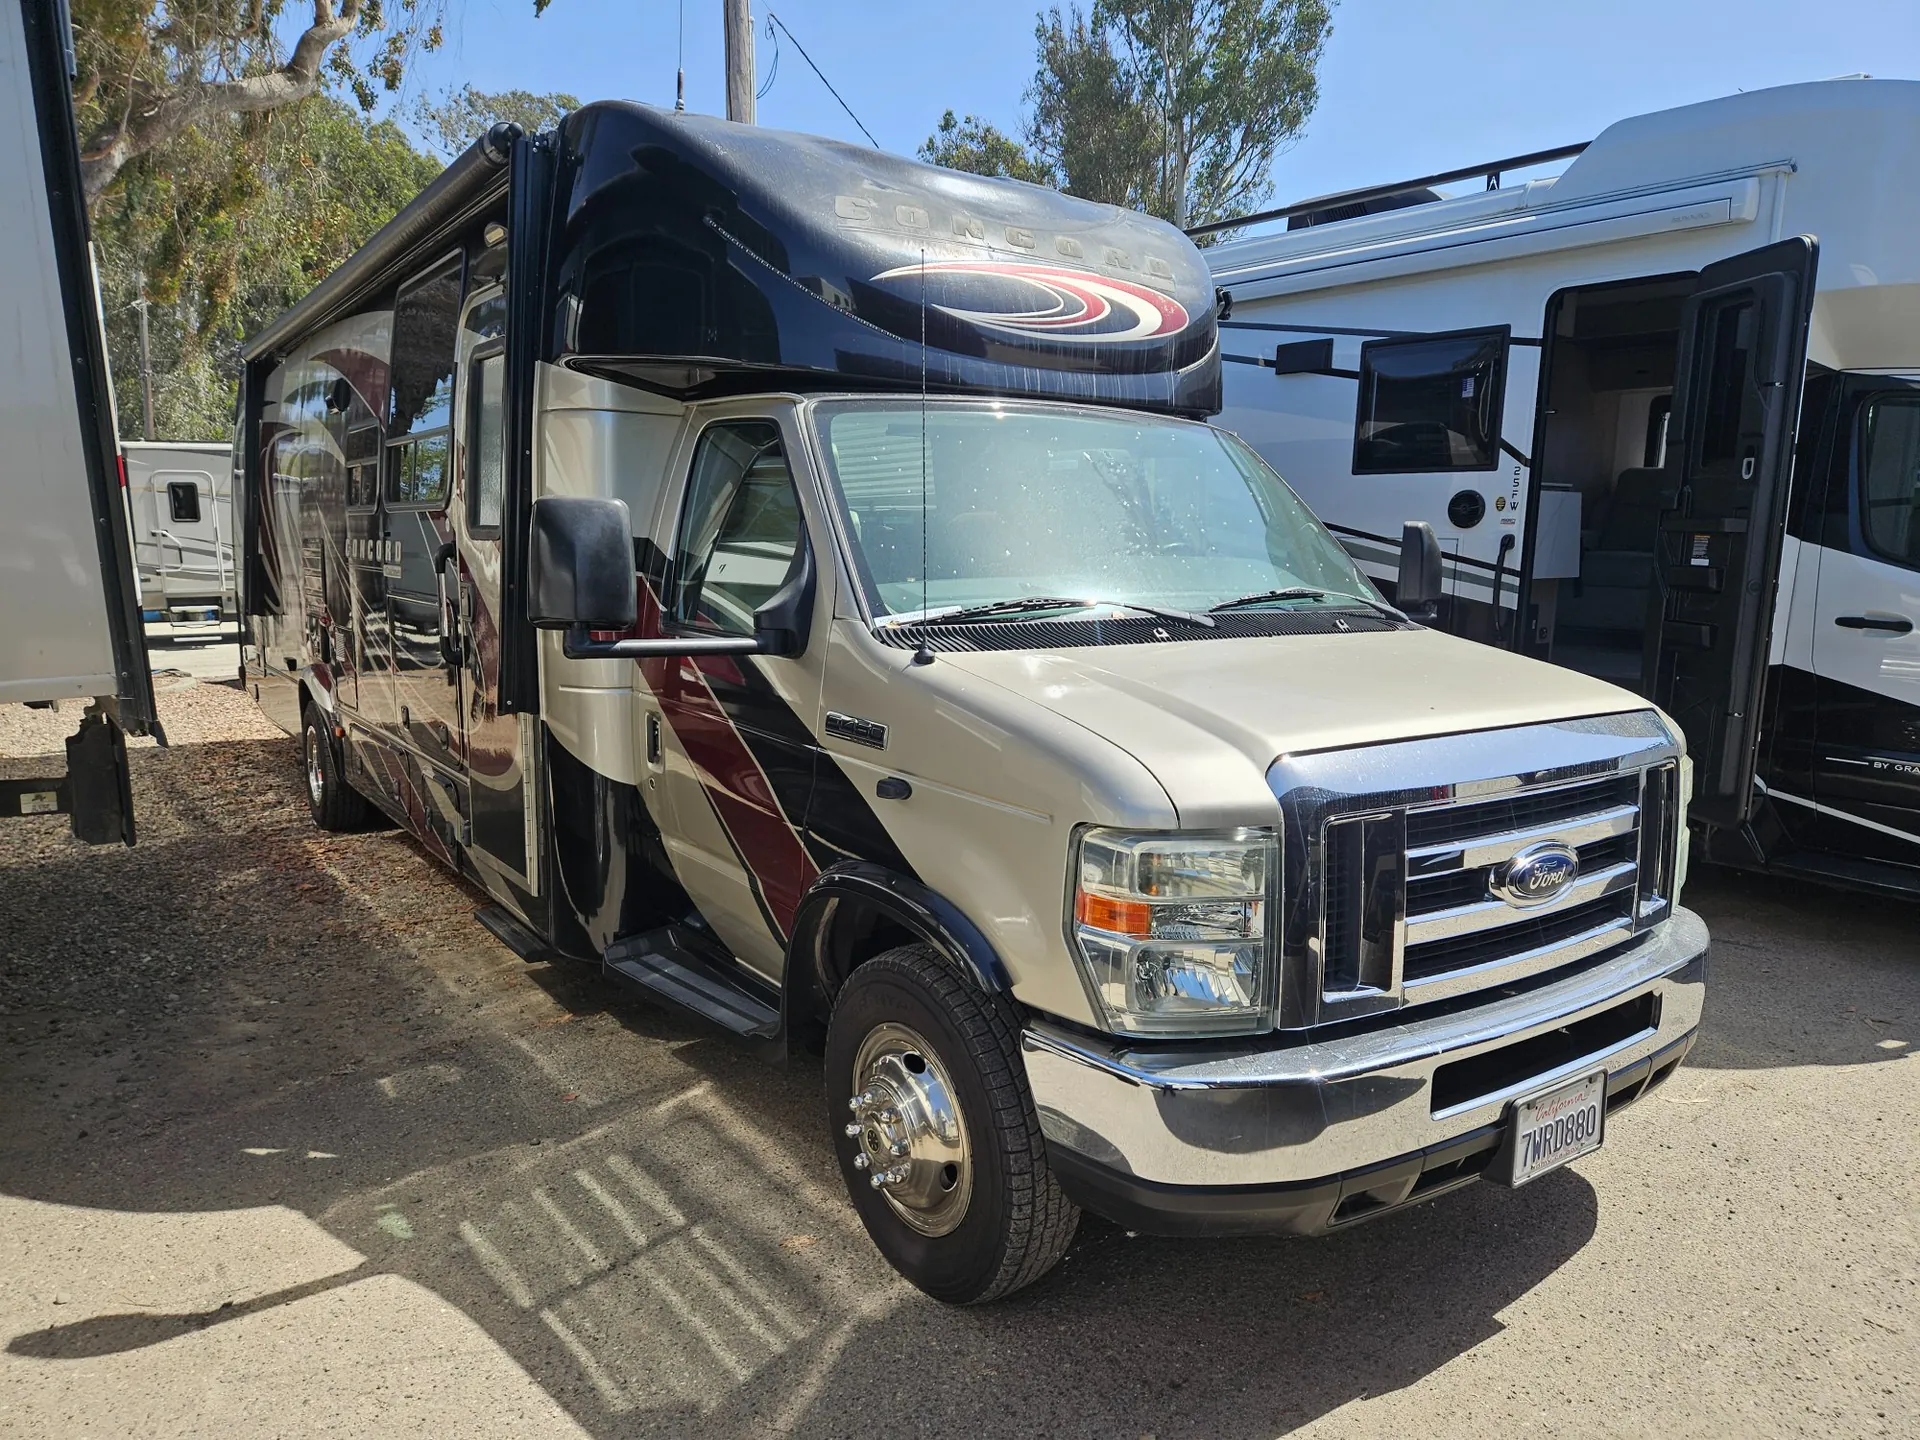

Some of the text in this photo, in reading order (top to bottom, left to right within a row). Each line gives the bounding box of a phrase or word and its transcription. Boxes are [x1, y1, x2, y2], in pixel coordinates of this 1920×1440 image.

[834, 195, 1172, 278] CONCORD
[1510, 466, 1521, 511] 25FW
[345, 538, 402, 562] CONCORD
[1873, 761, 1920, 775] BY GRA
[1530, 861, 1567, 890] Ford
[1535, 1091, 1589, 1122] California
[1522, 1104, 1597, 1168] 7WRD880
